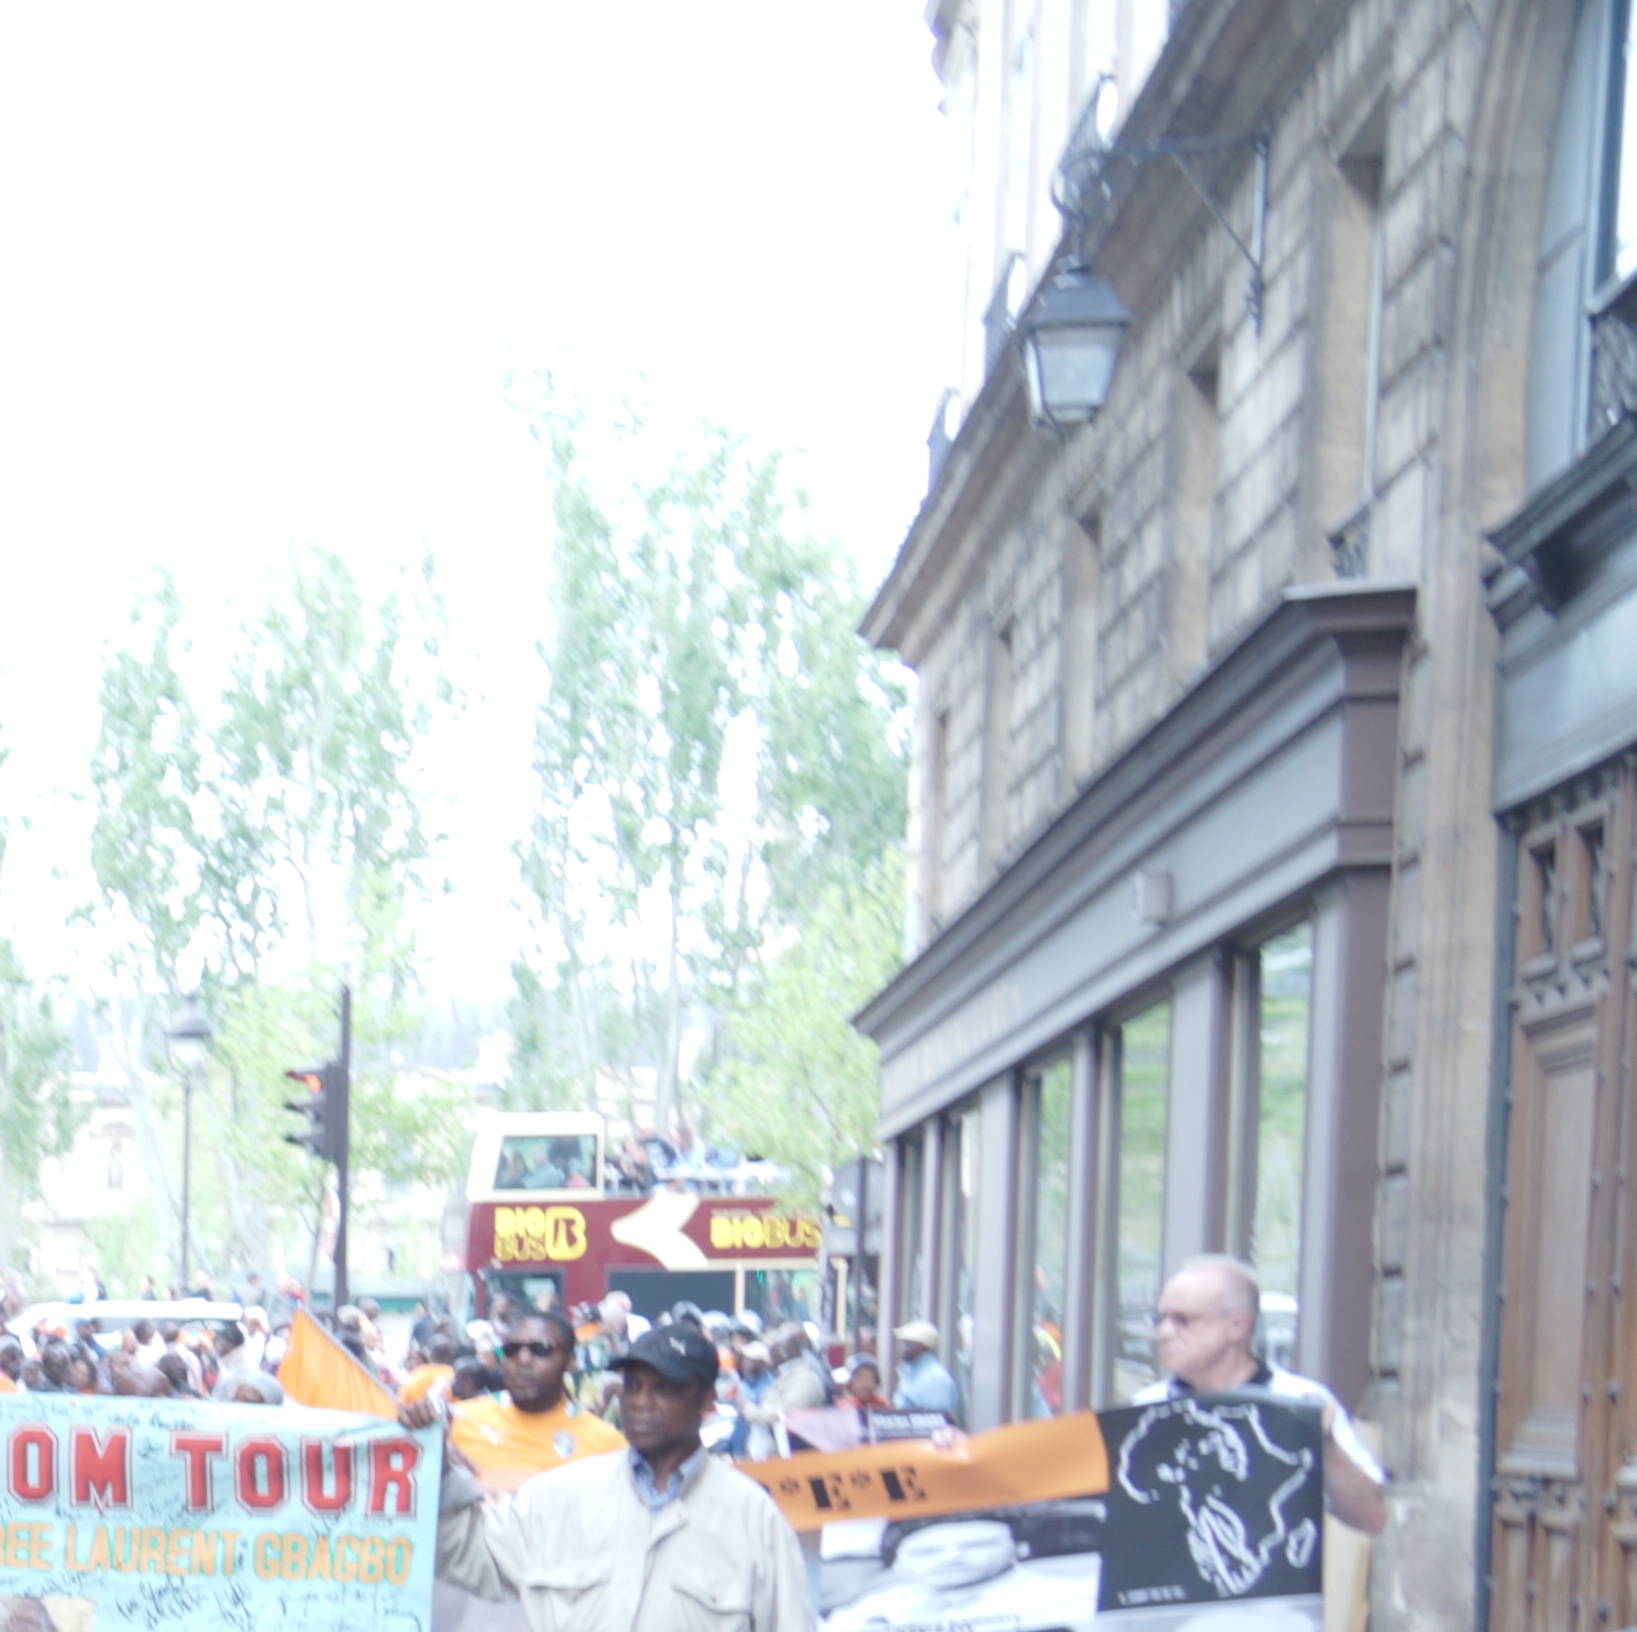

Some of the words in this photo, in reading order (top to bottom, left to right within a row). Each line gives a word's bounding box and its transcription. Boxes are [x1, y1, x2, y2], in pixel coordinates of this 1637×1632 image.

[170, 1429, 424, 1519] TOUR
[65, 1523, 243, 1577] LAURENT
[254, 1531, 413, 1586] GBAGBO
